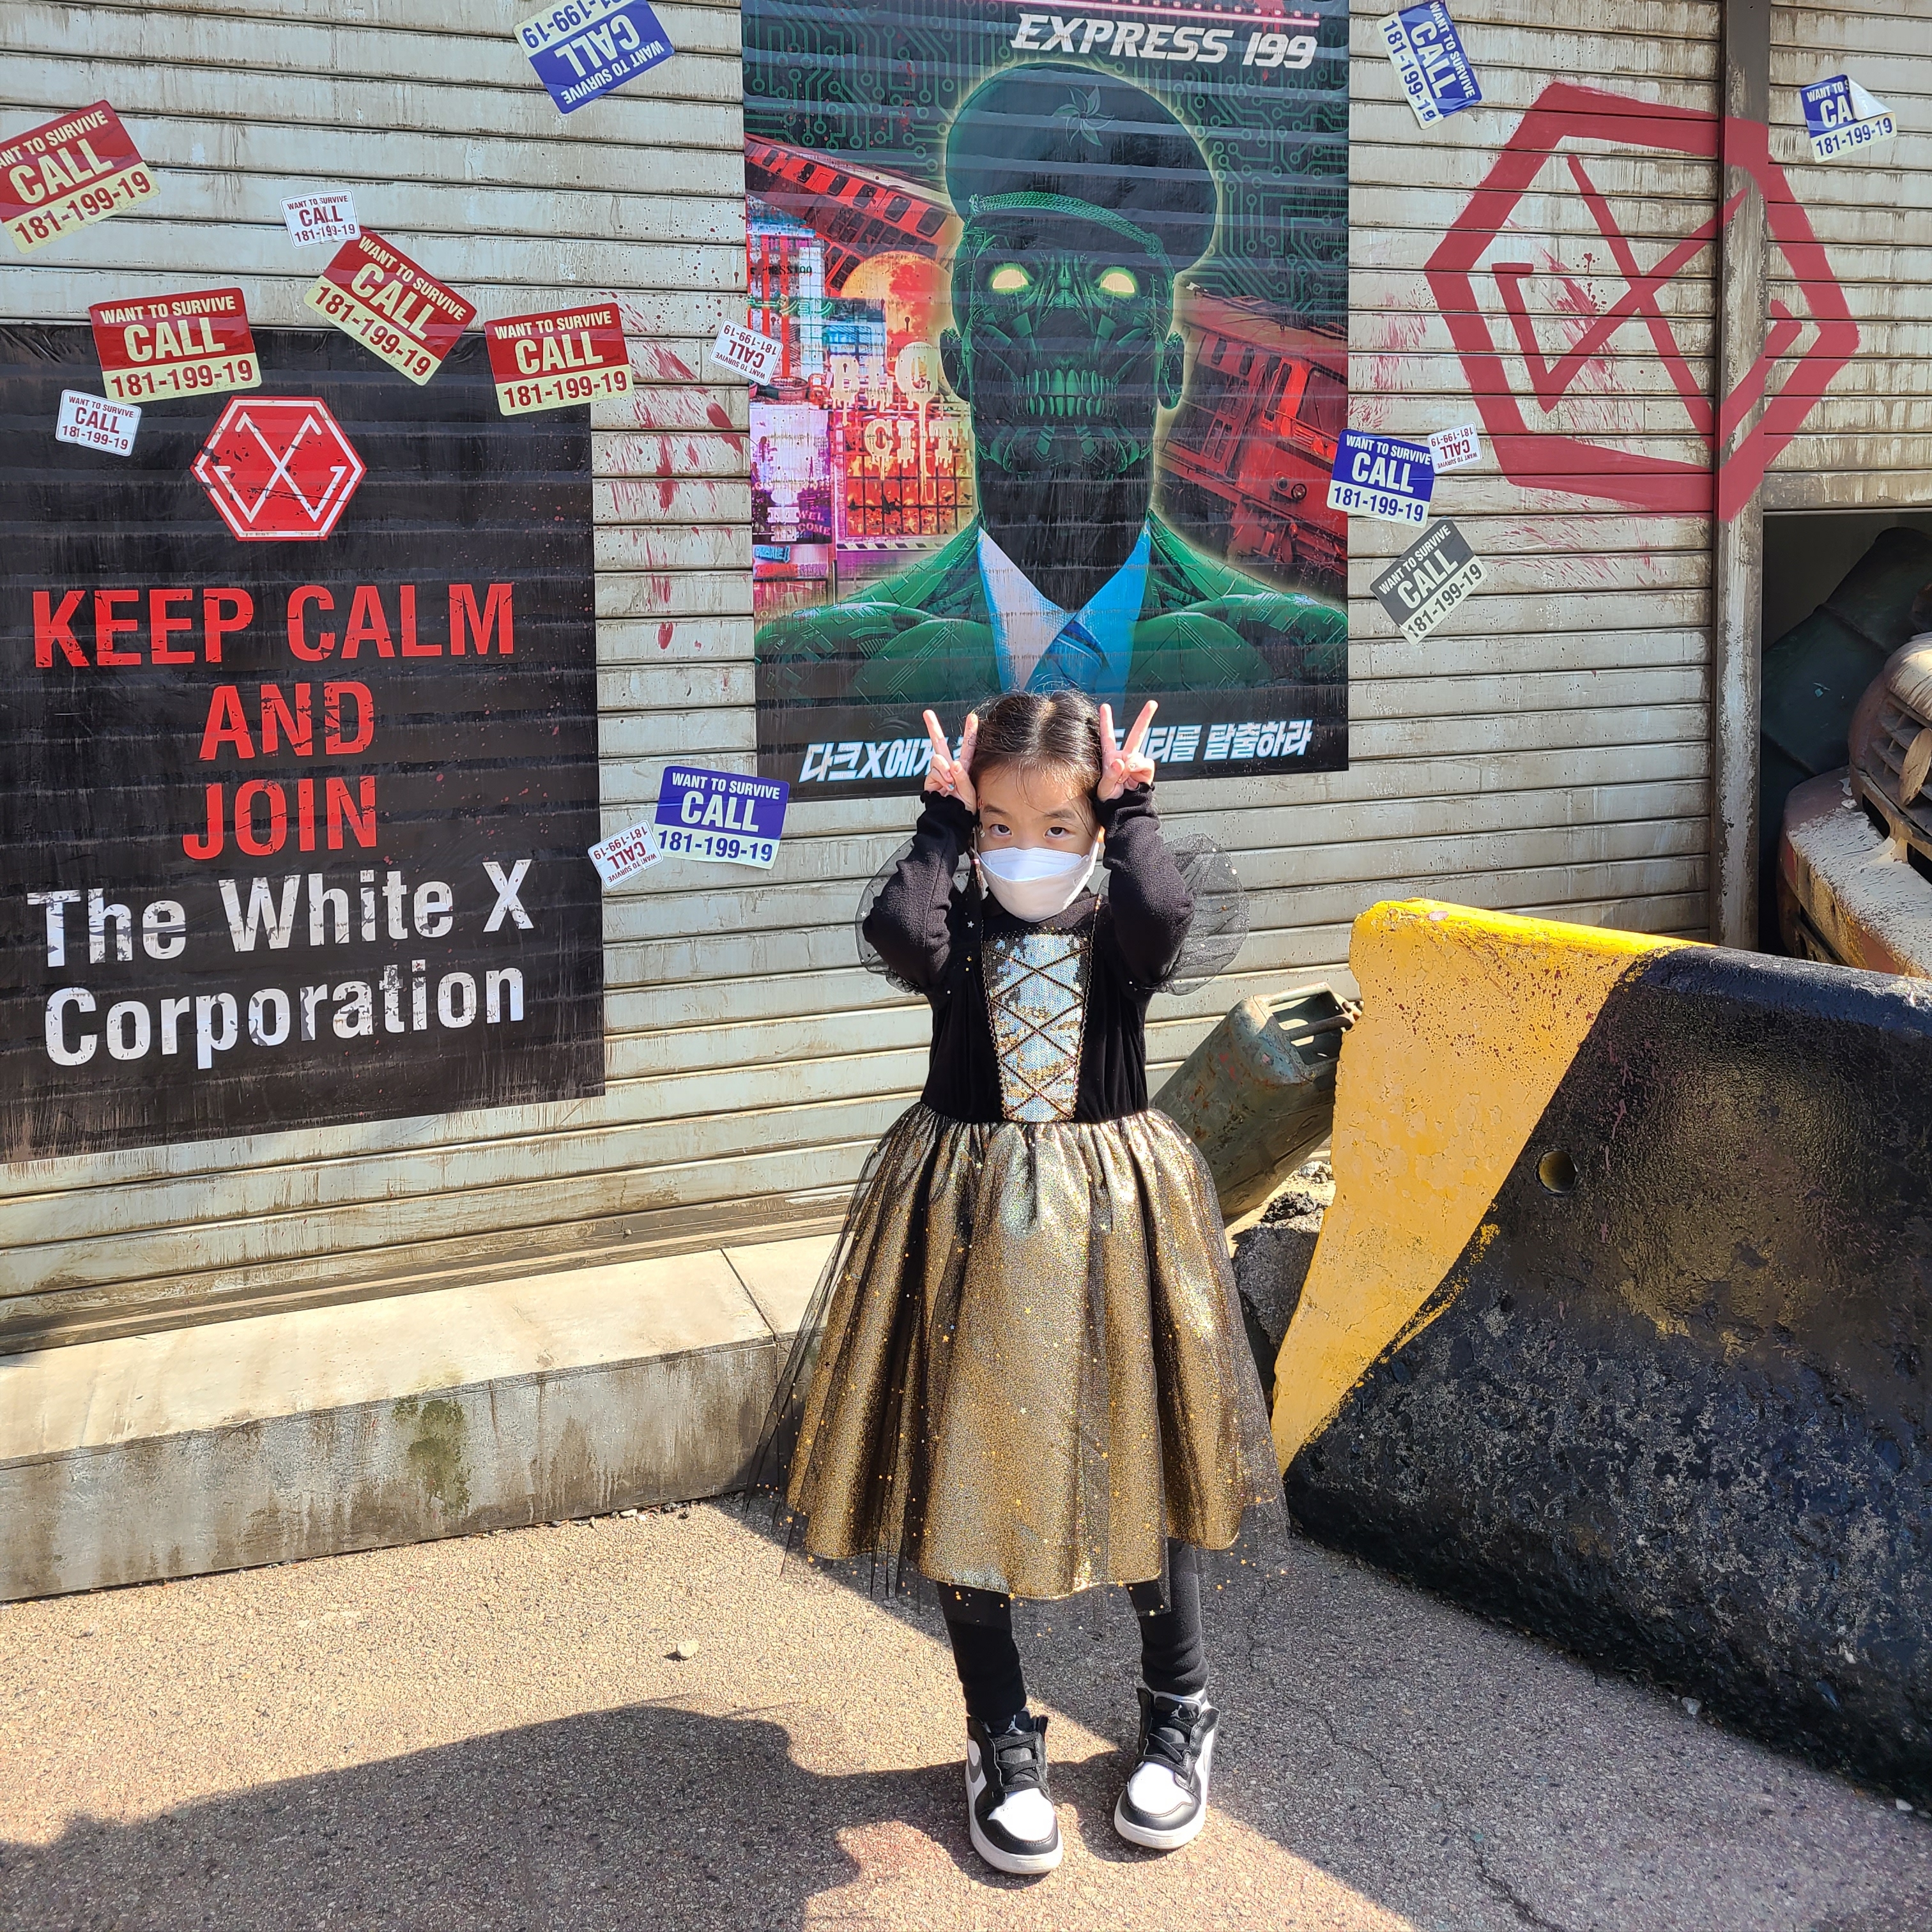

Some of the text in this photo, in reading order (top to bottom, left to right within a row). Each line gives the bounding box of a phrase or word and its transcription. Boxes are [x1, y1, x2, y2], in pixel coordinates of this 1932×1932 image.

[554, 14, 640, 78] CALL
[1009, 13, 1319, 69] EXPRESS 199
[1411, 20, 1457, 98] CALL
[1429, 2, 1476, 99] WANT TO SURVIVE
[561, 40, 664, 104] WANT TO SURVIVE
[1383, 20, 1437, 122] 181-199-19
[1806, 86, 1831, 103] WANT
[1832, 81, 1844, 94] TO
[1820, 95, 1853, 128] CA
[0, 110, 108, 169] ANT TO SURVIVE
[1816, 117, 1892, 156] 181-199-19
[9, 139, 114, 204] CALL
[15, 171, 151, 244] 181-199-19
[287, 200, 307, 210] WANT
[319, 195, 348, 204] SURVIVE
[299, 205, 343, 227] CALL
[295, 224, 355, 242] 181-199-19
[358, 236, 466, 321] WANT TO SURVIVE
[100, 296, 236, 325] WANT TO SURVIVE
[351, 263, 435, 341] CALL
[123, 317, 226, 362] CALL
[315, 286, 431, 376] 181-199-19
[494, 310, 612, 340] WANT TO SURVIVE
[723, 325, 777, 355] 181-199-19
[514, 331, 604, 375] CALL
[715, 352, 740, 367] SURVIVE
[728, 339, 765, 369] CALL
[111, 359, 253, 397] 181-199-19
[503, 371, 627, 408] 181-199-19
[749, 367, 765, 379] WANT
[68, 395, 134, 418] WANT TO SURVIVE
[75, 406, 119, 434] CALL
[62, 425, 128, 450] 181-199-19
[1346, 434, 1432, 465] WANT TO SURVIVE
[1431, 427, 1474, 447] 181-199-19
[1440, 440, 1470, 459] CALL
[1351, 452, 1414, 494] CALL
[1437, 459, 1457, 469] SURVIVE
[1464, 452, 1478, 461] WANT
[1334, 486, 1424, 522] 181-199-19
[1378, 525, 1452, 595] WANT TO SURVIVE
[1398, 549, 1459, 609] CALL
[1407, 564, 1482, 638] 181-199-19
[33, 583, 514, 668] KEEP CALM
[198, 681, 374, 761] AND
[1139, 724, 1202, 763] 티를
[1203, 719, 1314, 762] 탈출하라
[672, 772, 781, 800] WANT TO SURVIVE
[182, 774, 378, 861] JOIN
[680, 790, 759, 832] CALL
[594, 826, 648, 860] 181-199-19
[606, 841, 646, 870] CALL
[658, 830, 772, 862] 181-199-19
[608, 853, 657, 882] WANT TO SURVIVE
[27, 859, 535, 967] The White X
[45, 959, 524, 1070] Corporation
